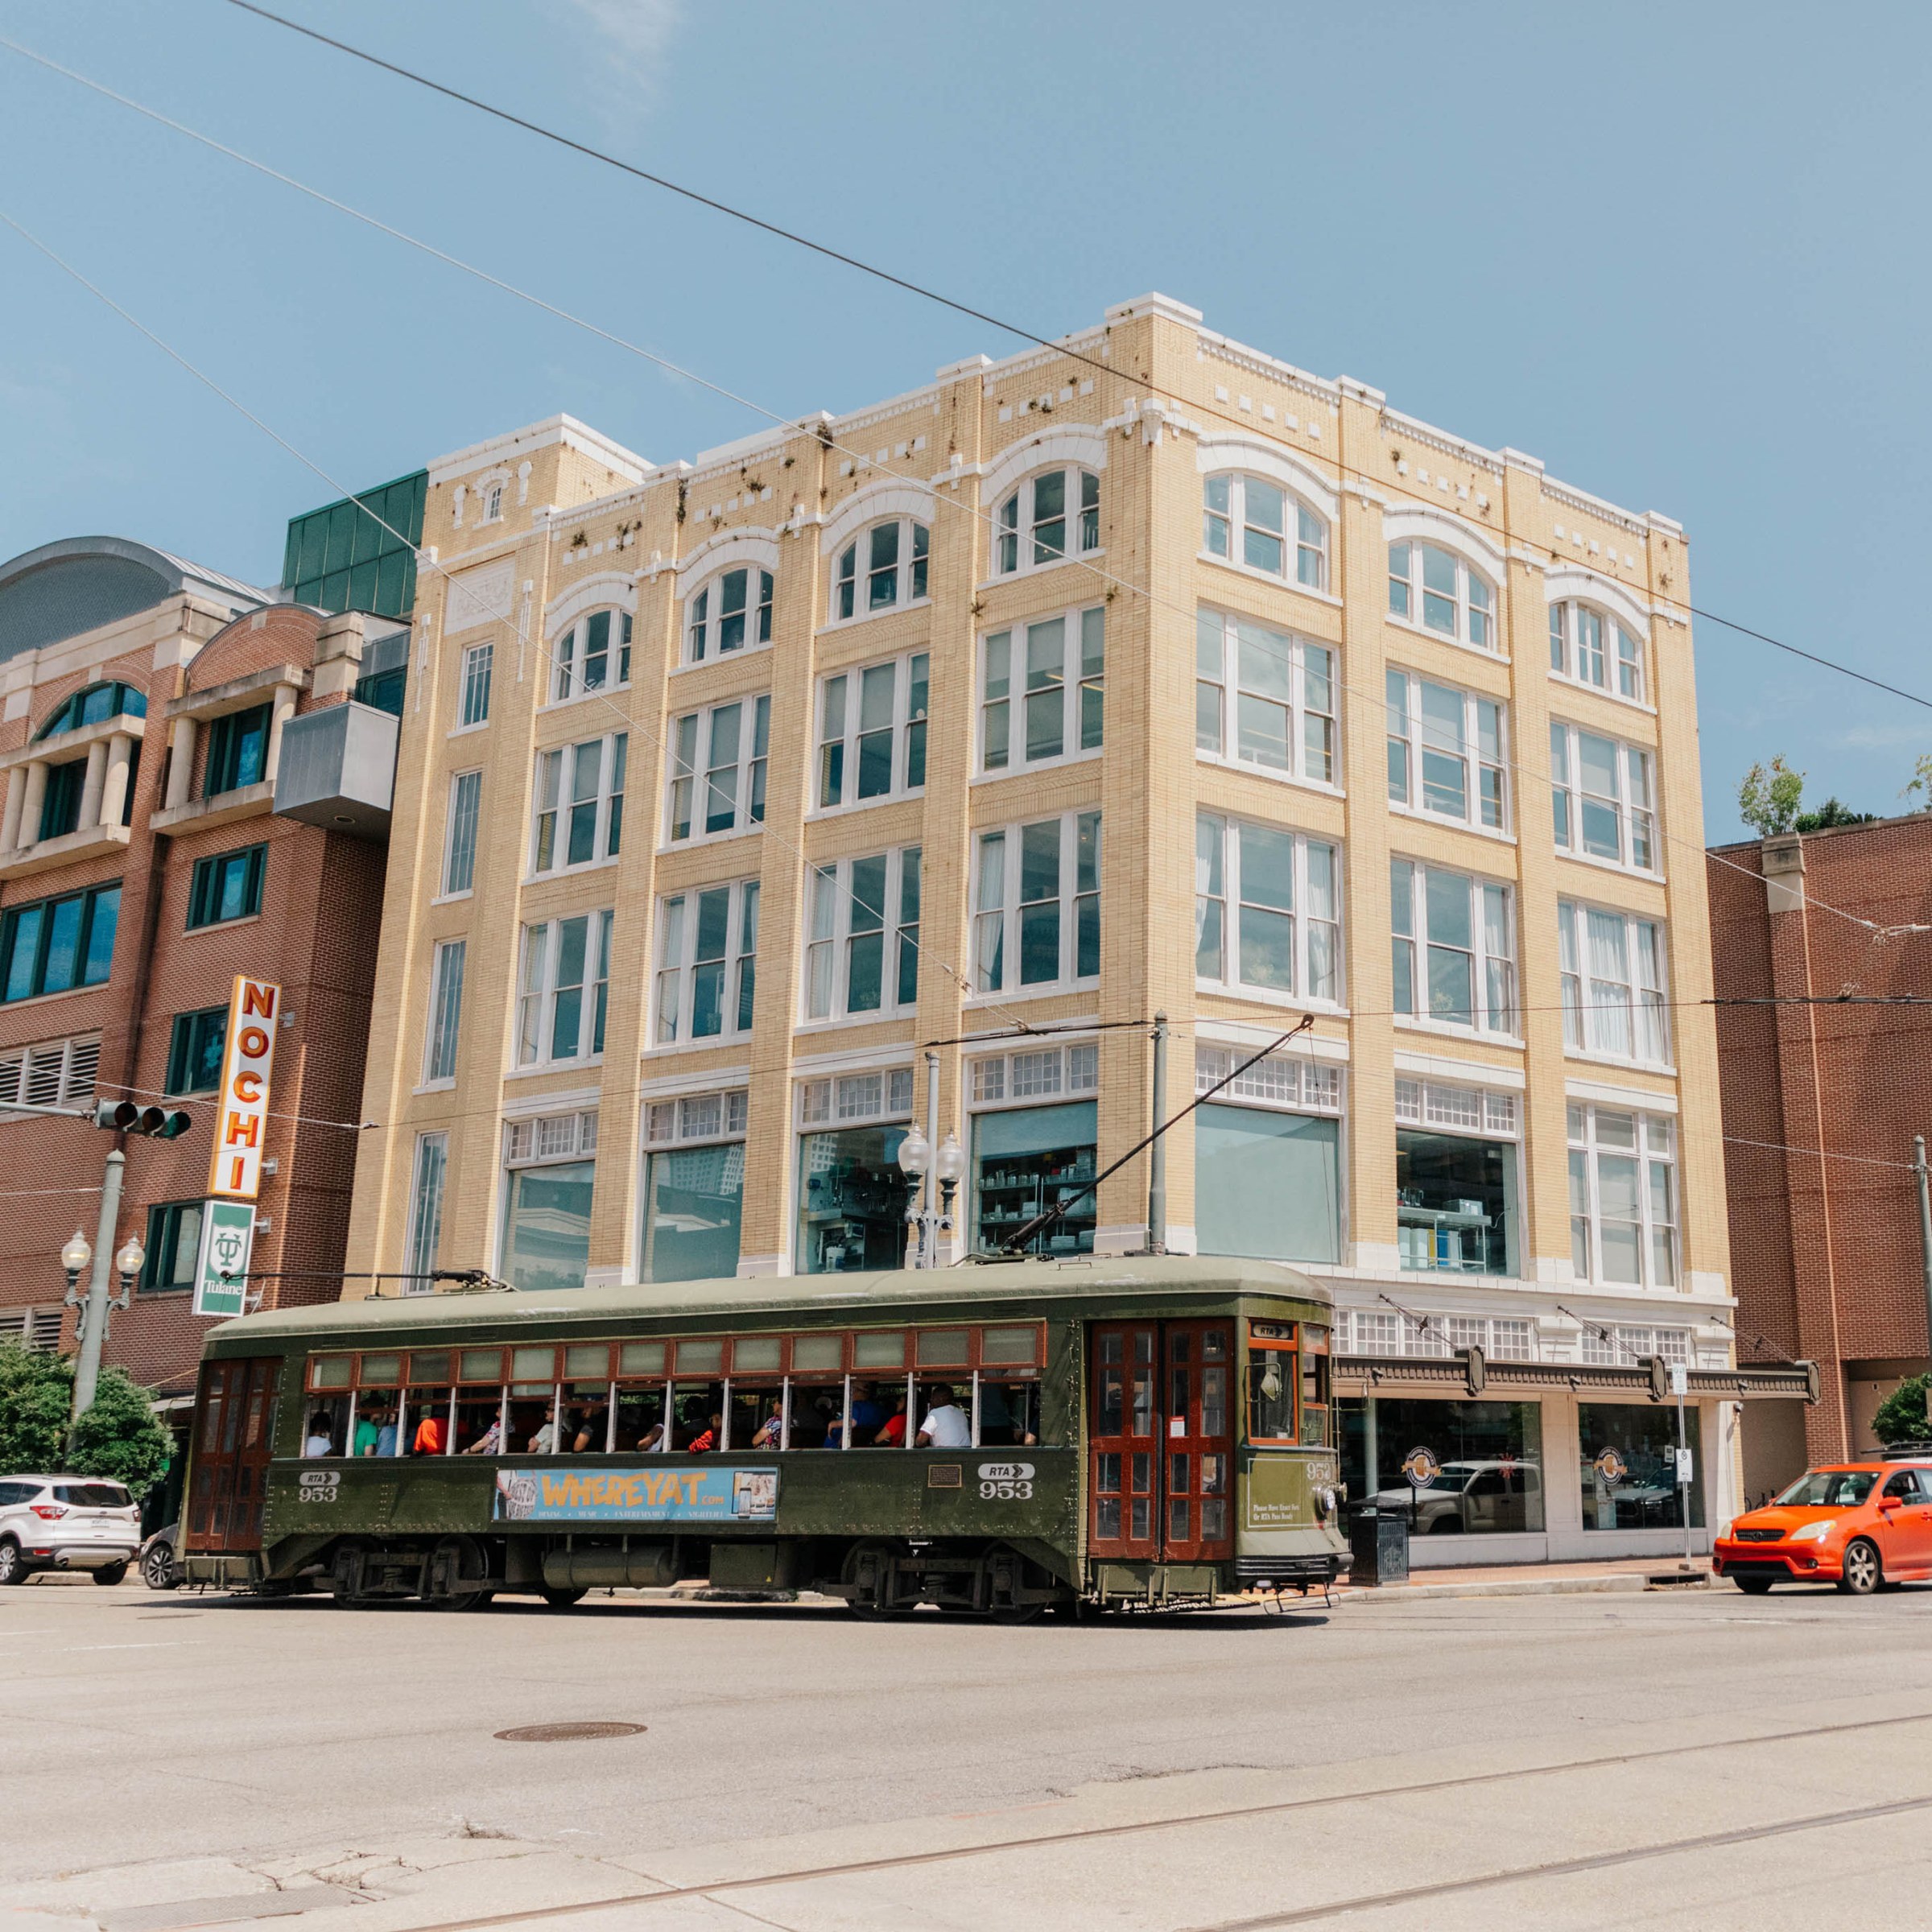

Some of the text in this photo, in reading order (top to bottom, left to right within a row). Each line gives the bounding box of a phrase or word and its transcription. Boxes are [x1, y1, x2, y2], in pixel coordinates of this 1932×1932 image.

[226, 981, 275, 1191] NOCHI
[204, 1279, 242, 1296] Tulane
[1261, 1327, 1274, 1335] RTA
[308, 1475, 323, 1483] RTA
[989, 1467, 1009, 1476] RTA
[299, 1486, 337, 1503] 953
[980, 1481, 1033, 1500] 953
